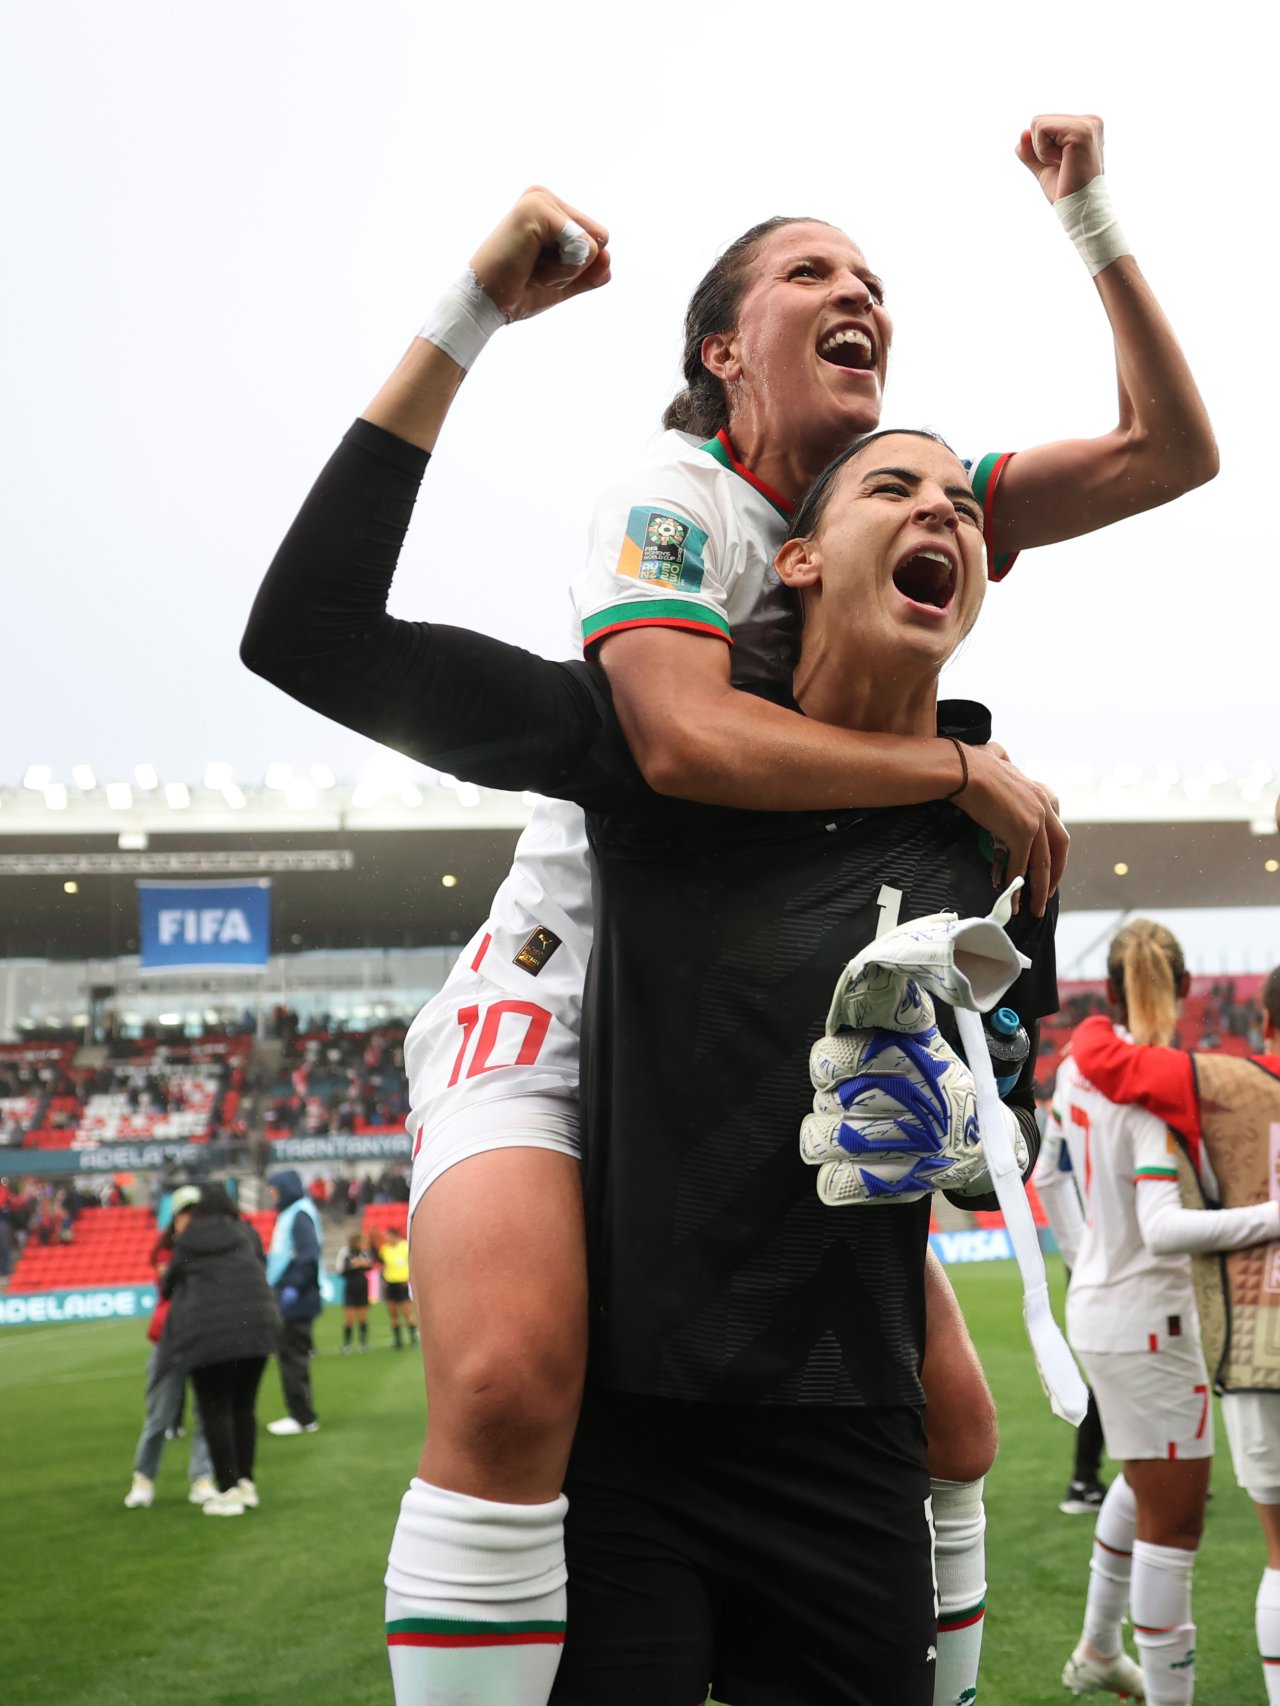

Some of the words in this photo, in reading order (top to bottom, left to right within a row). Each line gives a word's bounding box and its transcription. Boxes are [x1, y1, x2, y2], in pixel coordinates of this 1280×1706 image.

[640, 569, 657, 579] NZ
[641, 561, 659, 570] AU
[158, 908, 252, 944] FIFA
[447, 1000, 553, 1088] 10
[940, 1230, 1010, 1263] VISA
[1193, 1384, 1208, 1440] 7
